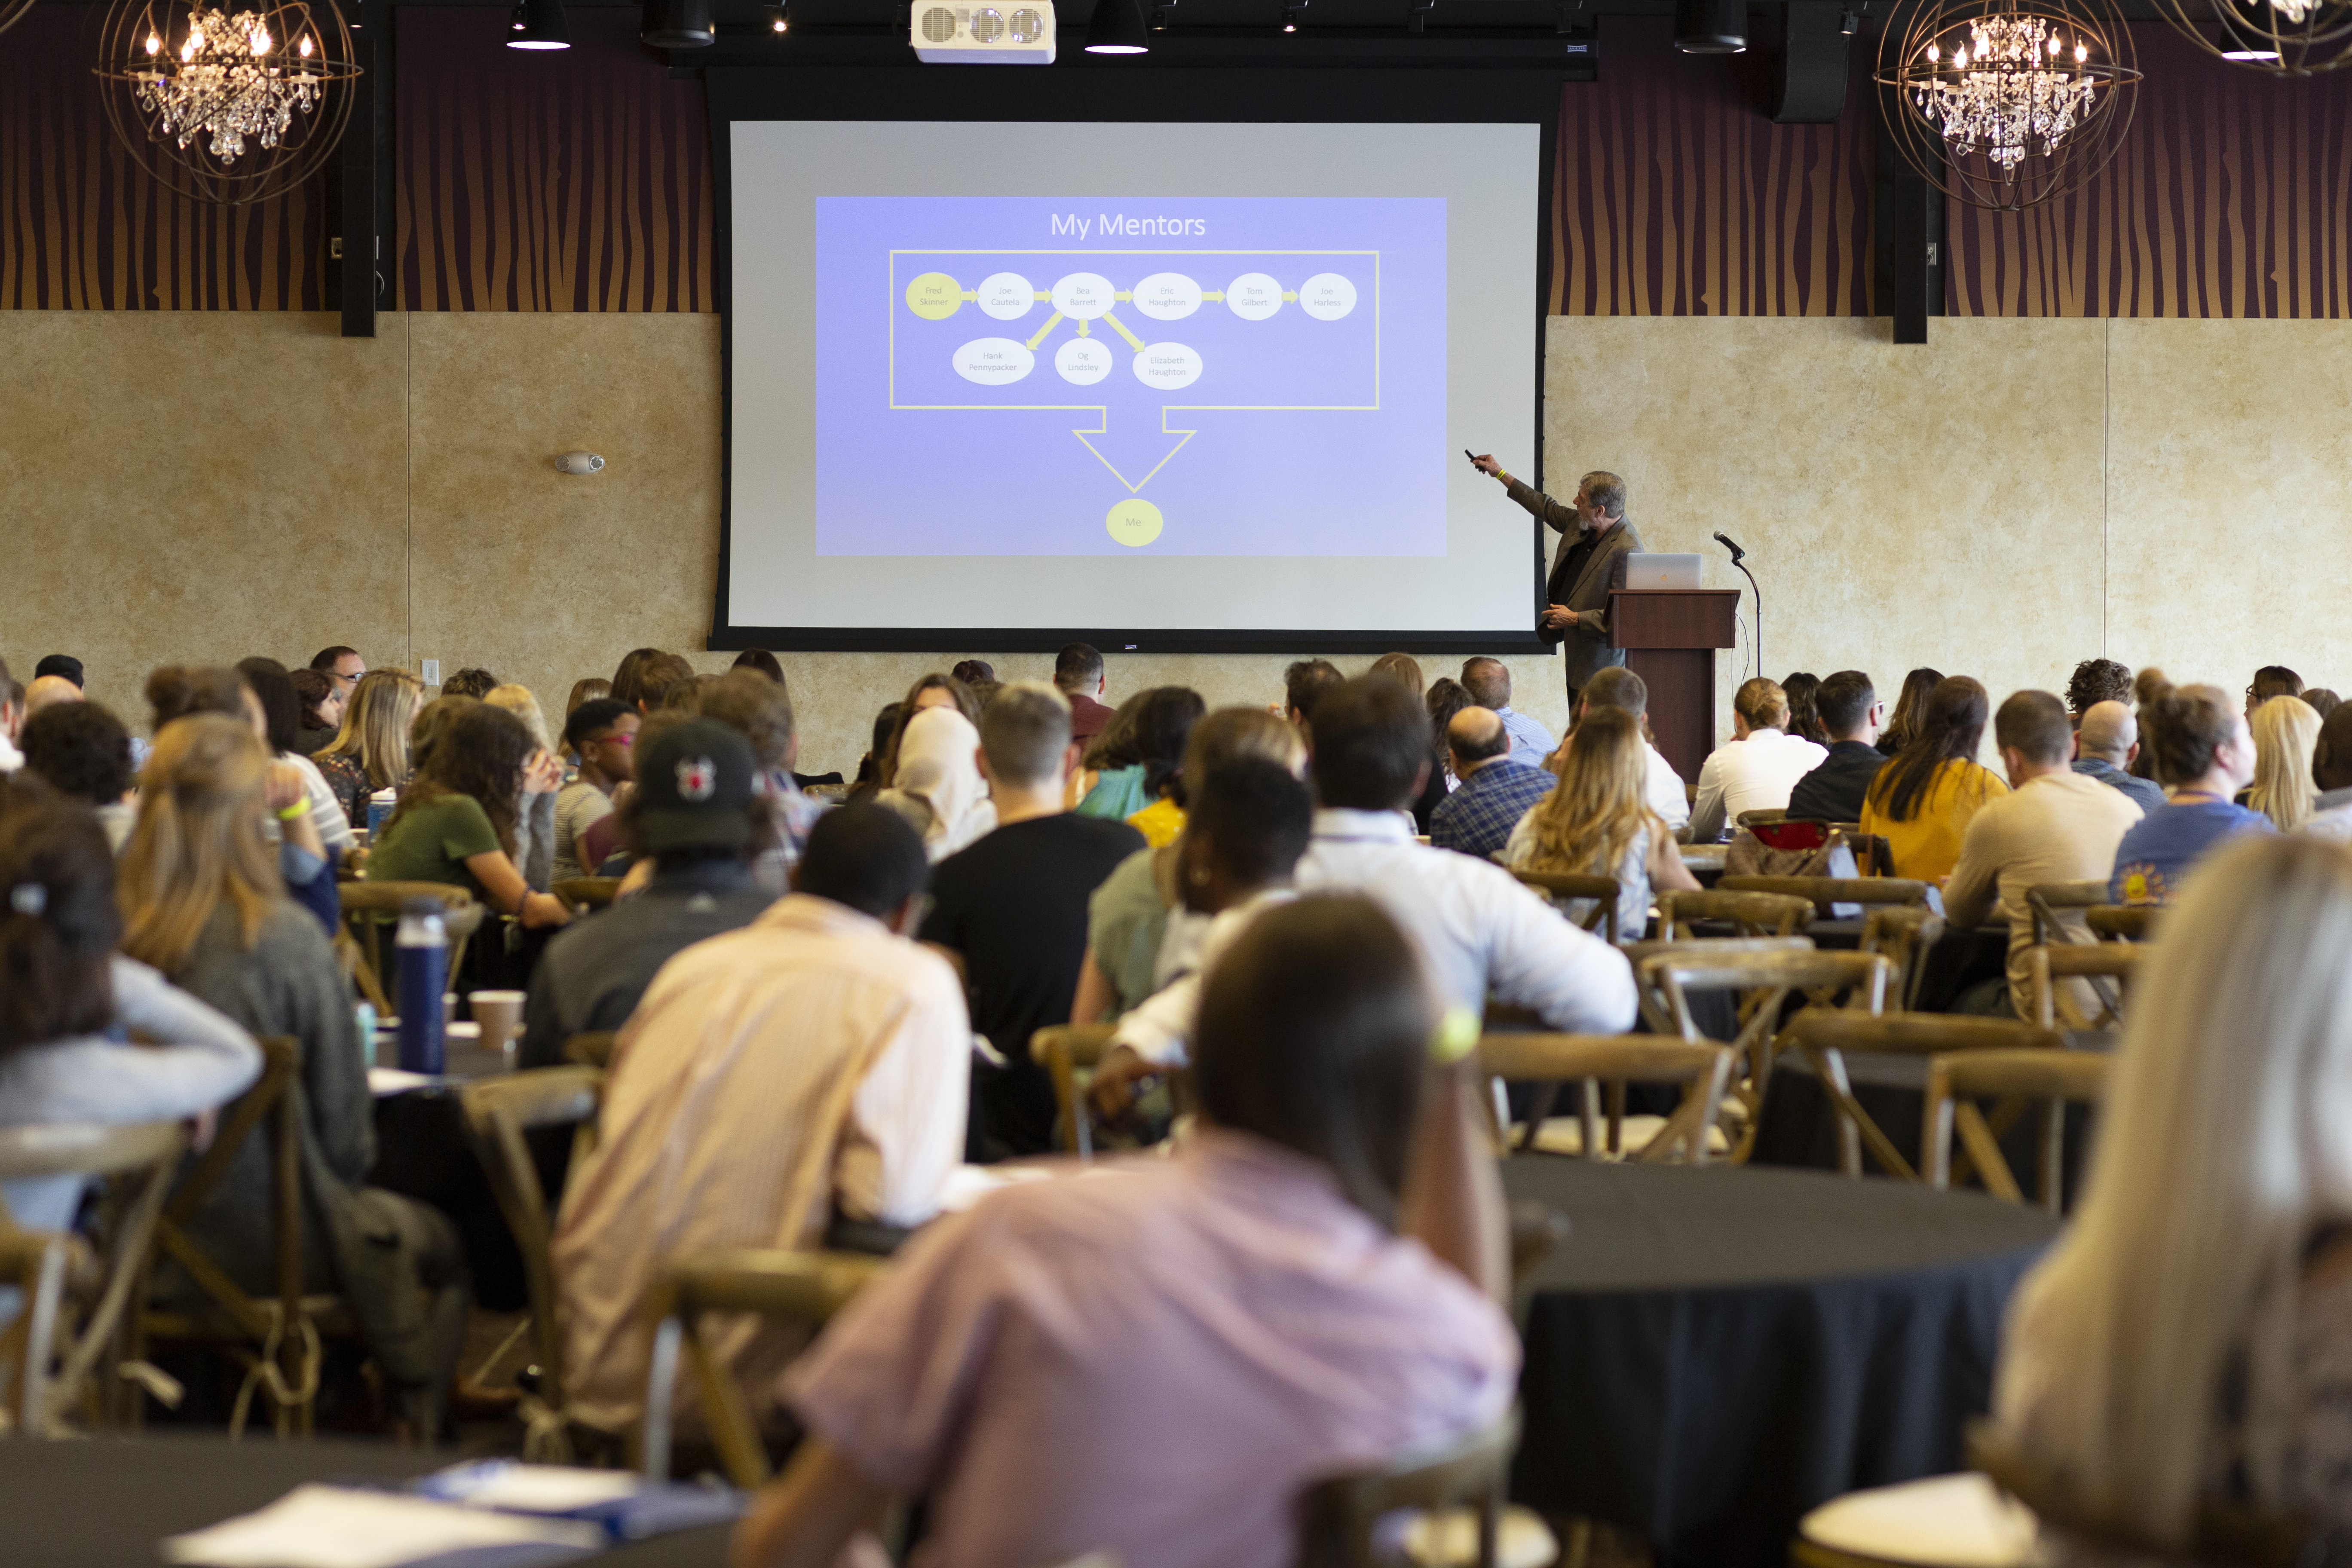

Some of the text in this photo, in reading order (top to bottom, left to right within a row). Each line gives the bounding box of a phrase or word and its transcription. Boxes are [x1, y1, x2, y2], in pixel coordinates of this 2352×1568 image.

[1052, 214, 1205, 240] My Mentors
[1149, 298, 1186, 307] Haughton
[1078, 352, 1089, 361] Og
[969, 364, 1017, 372] Pennypacker
[1068, 364, 1099, 372] Lindsley
[1149, 368, 1186, 377] Haughton
[1126, 518, 1142, 527] Me
